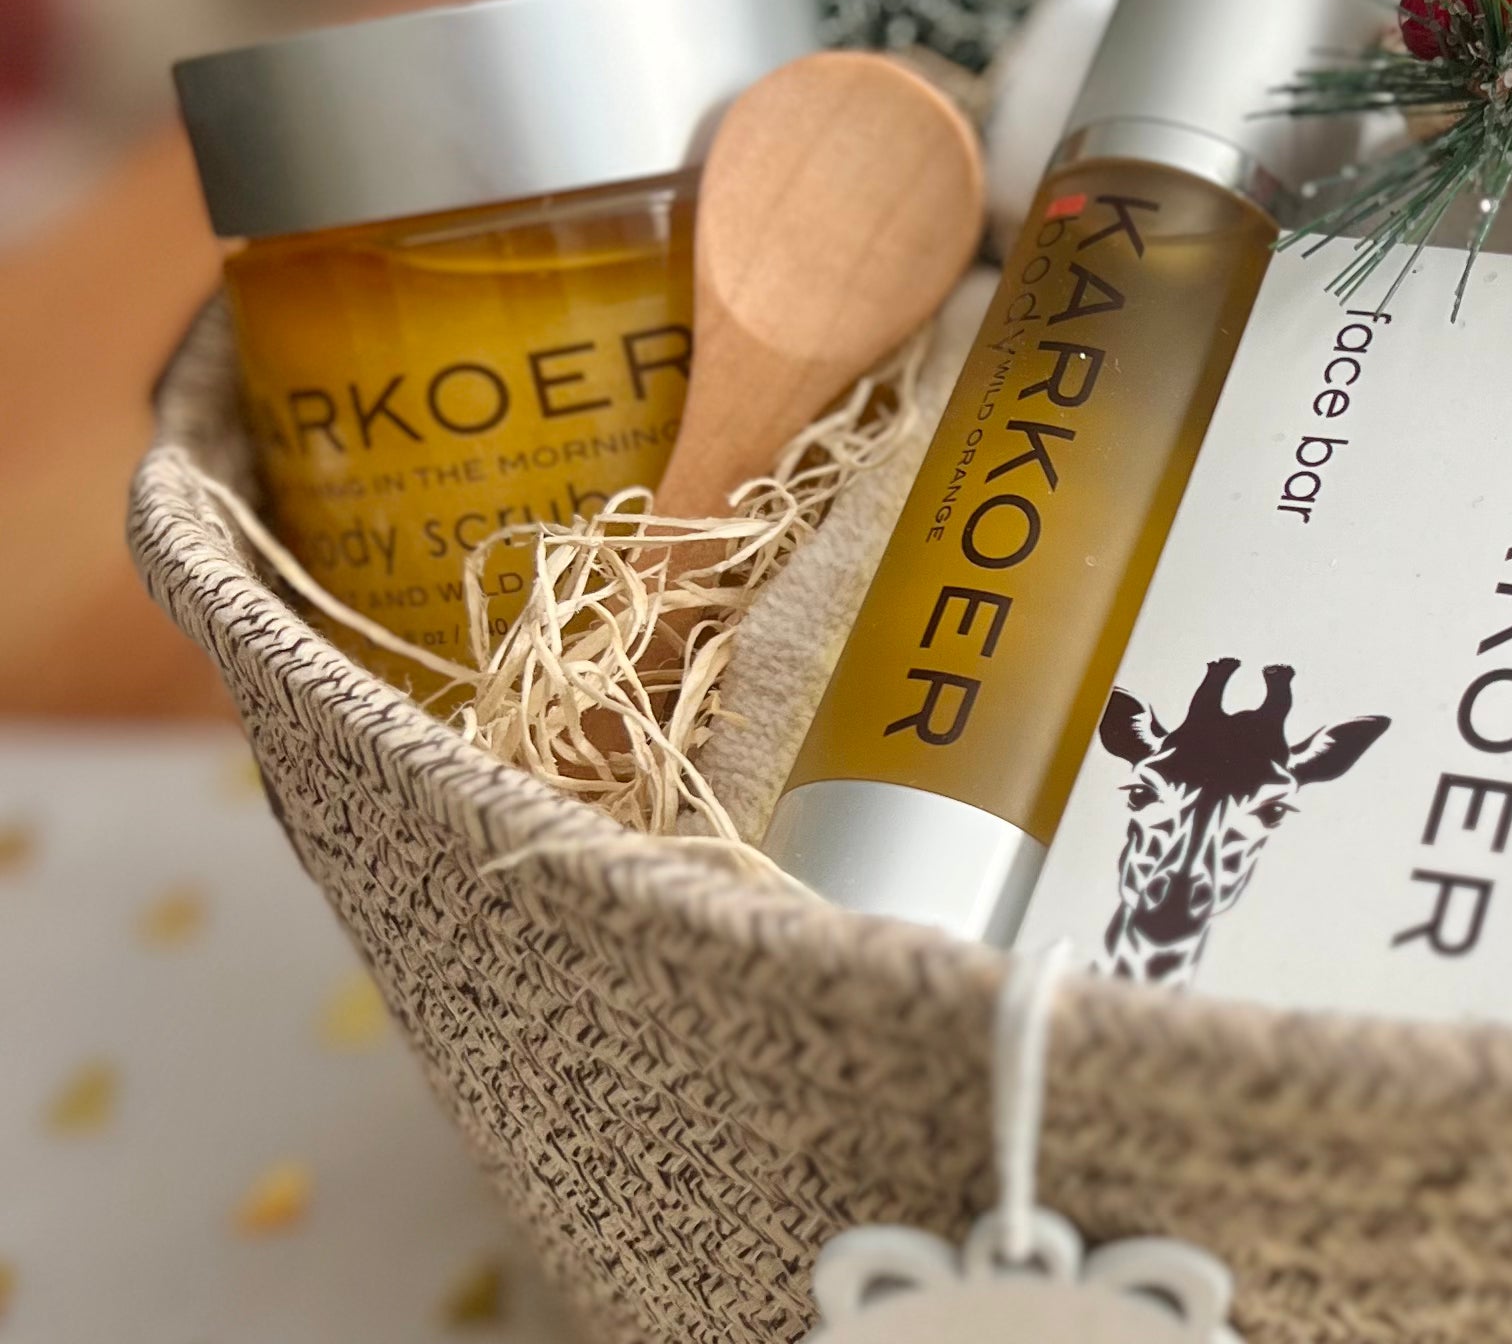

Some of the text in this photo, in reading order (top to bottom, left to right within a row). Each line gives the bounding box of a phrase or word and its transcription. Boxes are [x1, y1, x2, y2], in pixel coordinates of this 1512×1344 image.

[413, 458, 487, 489] THE
[883, 194, 1161, 747] KARKOER
[925, 215, 1080, 544] body WILD ORANGE
[1277, 309, 1393, 524] face bar
[436, 571, 524, 603] WLD
